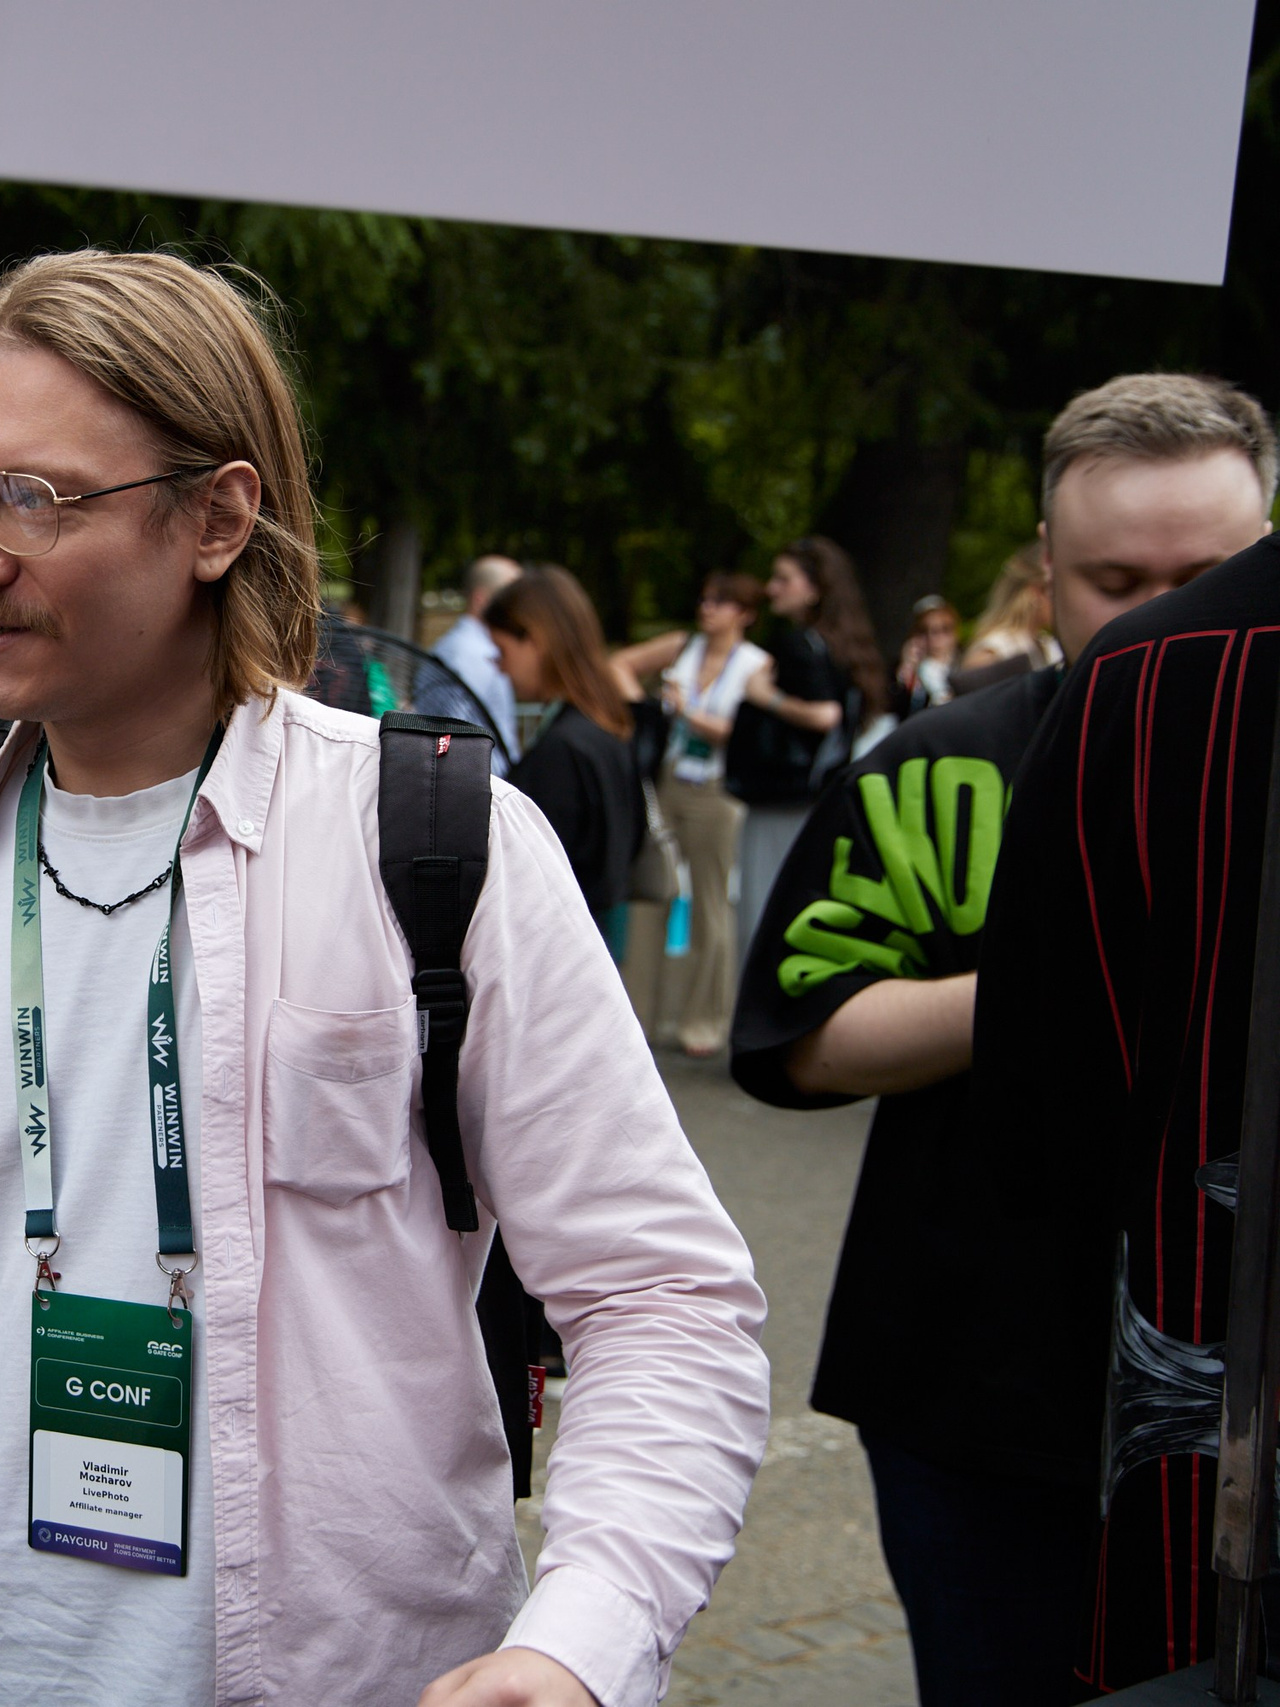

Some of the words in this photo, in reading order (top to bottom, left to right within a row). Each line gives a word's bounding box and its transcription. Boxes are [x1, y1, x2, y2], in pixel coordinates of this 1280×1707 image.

[17, 1007, 34, 1090] WINWIN
[156, 1104, 165, 1148] PARTNERS
[164, 1082, 183, 1169] WINWIN
[47, 1328, 75, 1336] AFFILIATE
[75, 1331, 105, 1340] BUSINESS
[47, 1333, 85, 1342] CONFERENCE
[153, 1349, 167, 1357] GATE
[167, 1351, 183, 1359] CONF
[65, 1376, 84, 1397] G
[89, 1380, 151, 1407] CONF
[82, 1460, 129, 1477] Vladimir
[79, 1470, 132, 1488] Mozharov
[82, 1487, 130, 1502] LivePhoto
[69, 1500, 103, 1513] Affiliate
[105, 1507, 143, 1520] manager
[55, 1532, 108, 1551] PAYGURU
[113, 1542, 131, 1551] WHERE
[132, 1545, 156, 1555] PAYMENT
[113, 1548, 131, 1557] FLOWS
[132, 1551, 156, 1561] CONVERT
[156, 1556, 176, 1565] BETTER
